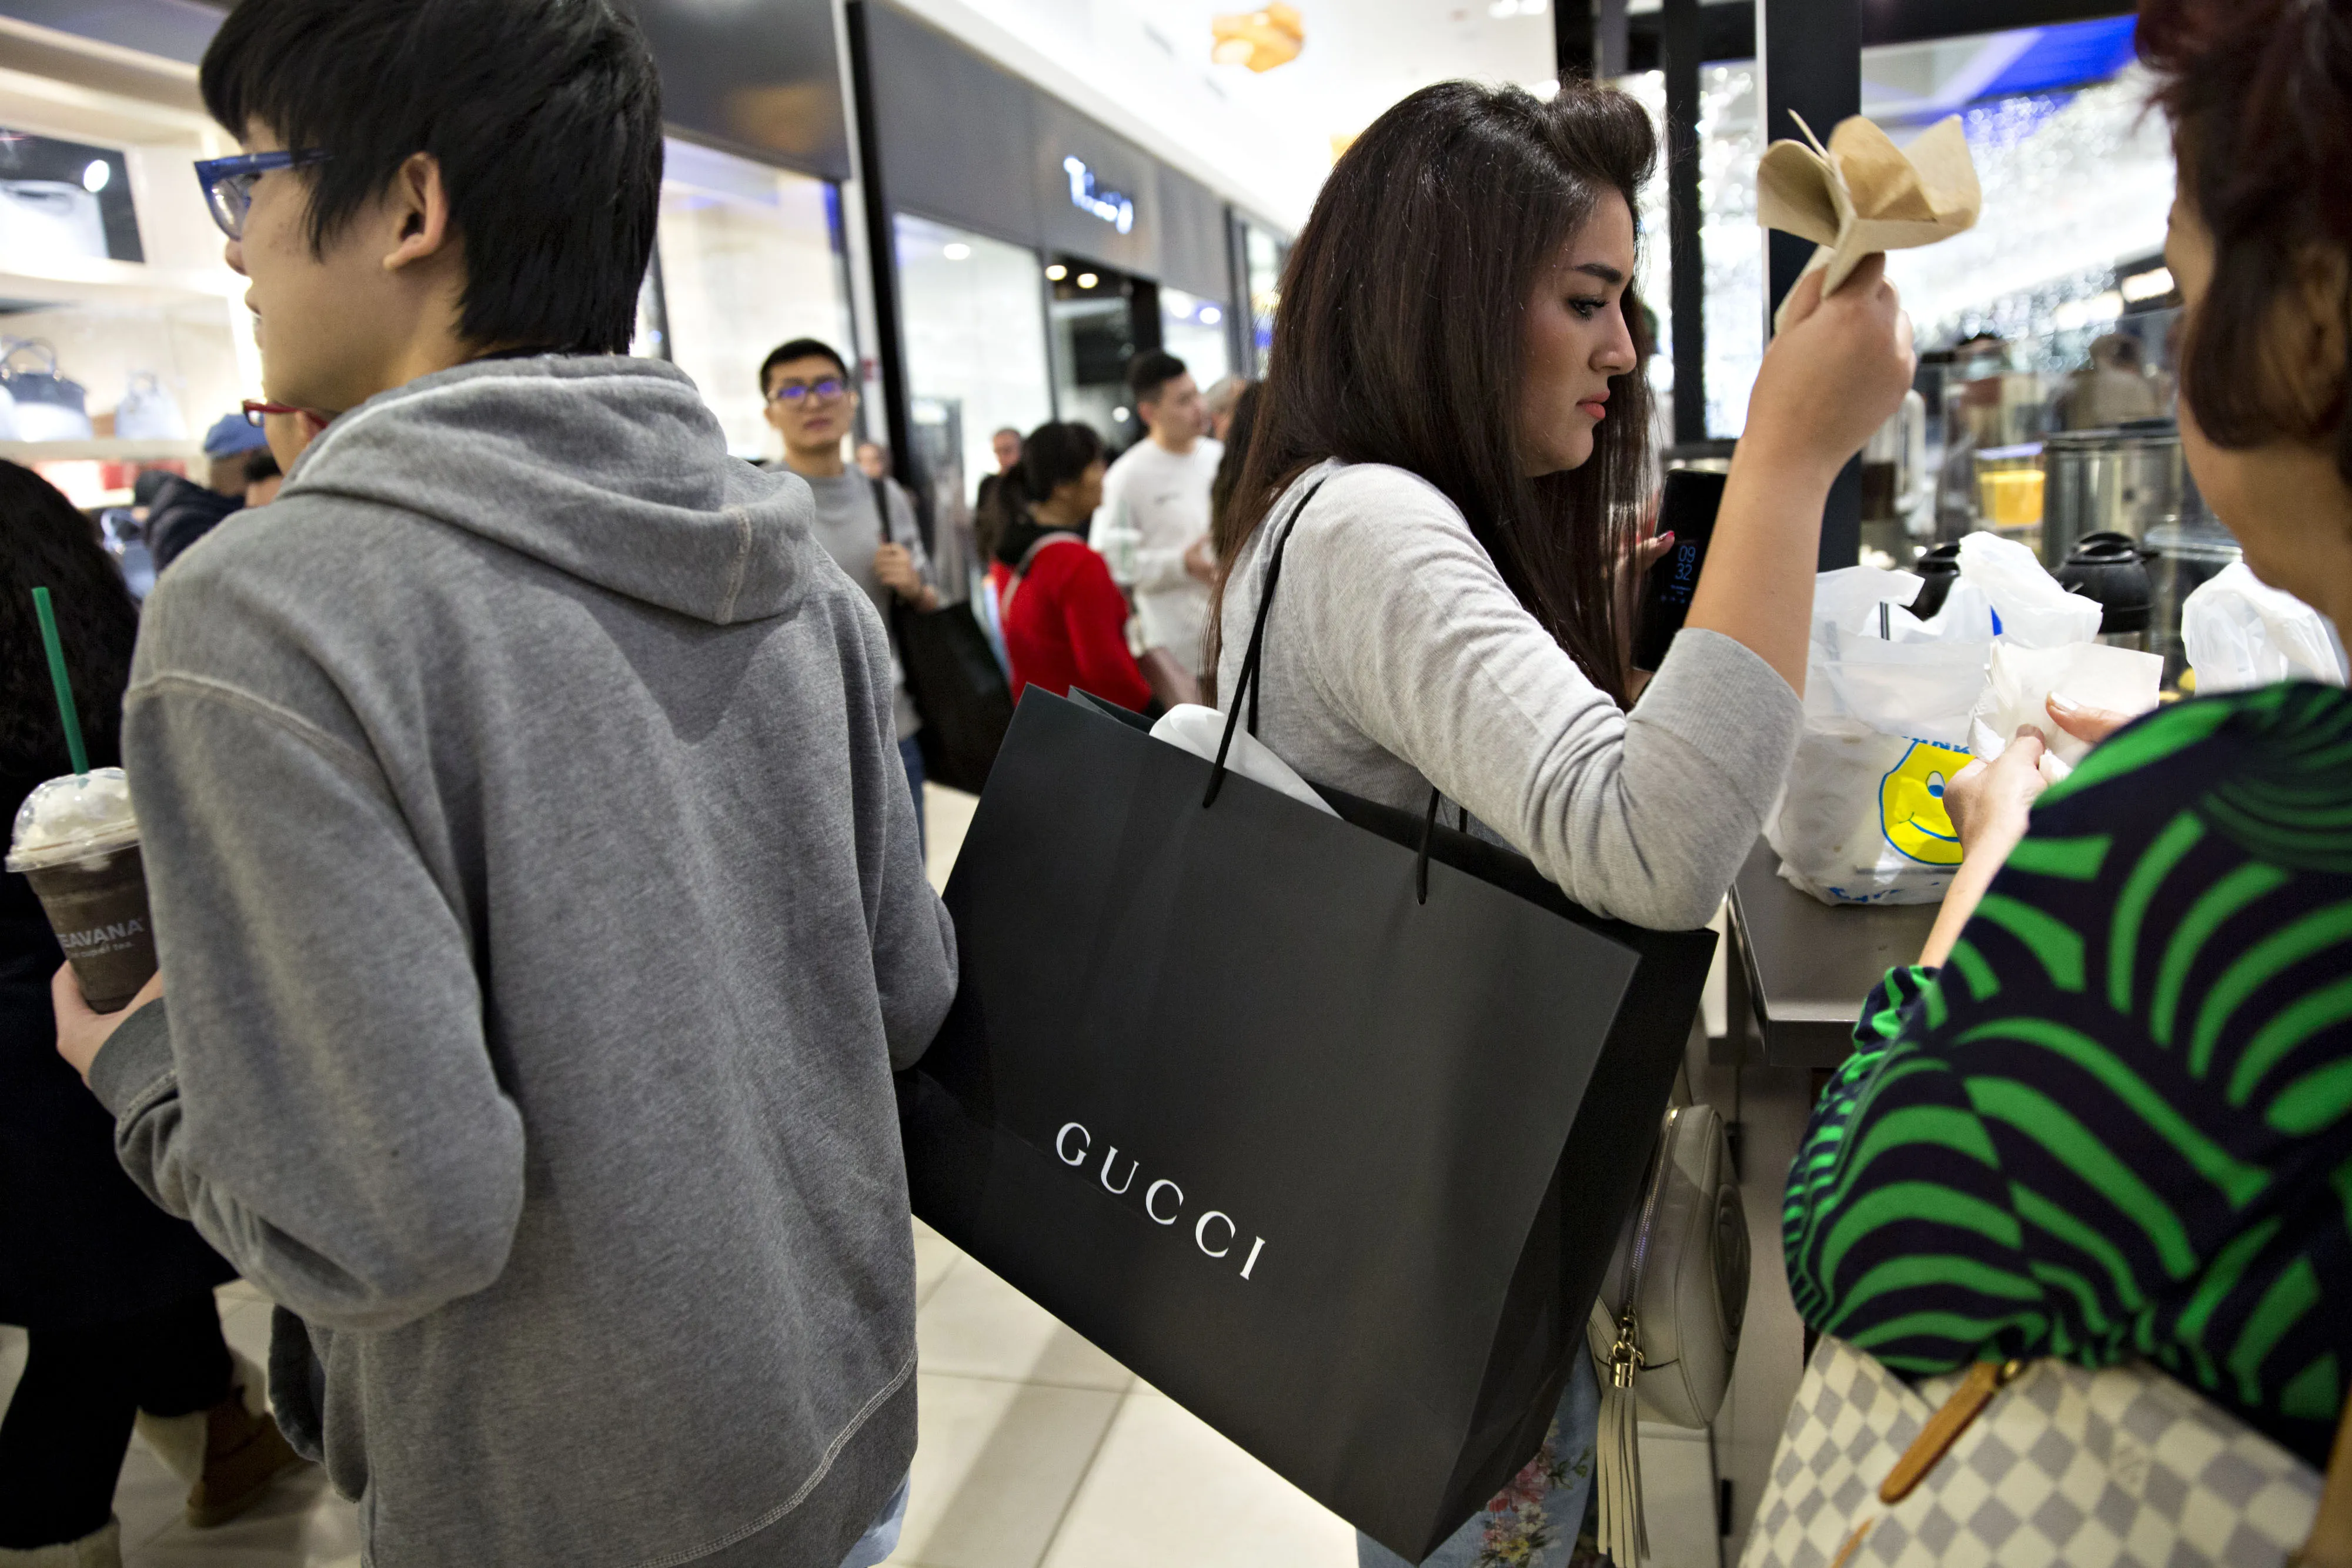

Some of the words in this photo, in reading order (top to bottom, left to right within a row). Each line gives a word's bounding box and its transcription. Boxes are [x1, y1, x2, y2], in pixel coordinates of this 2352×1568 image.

[1678, 546, 1696, 563] 09
[1675, 563, 1692, 581] 32
[56, 920, 143, 948] EAVANA
[1055, 1122, 1265, 1281] GUCCI
